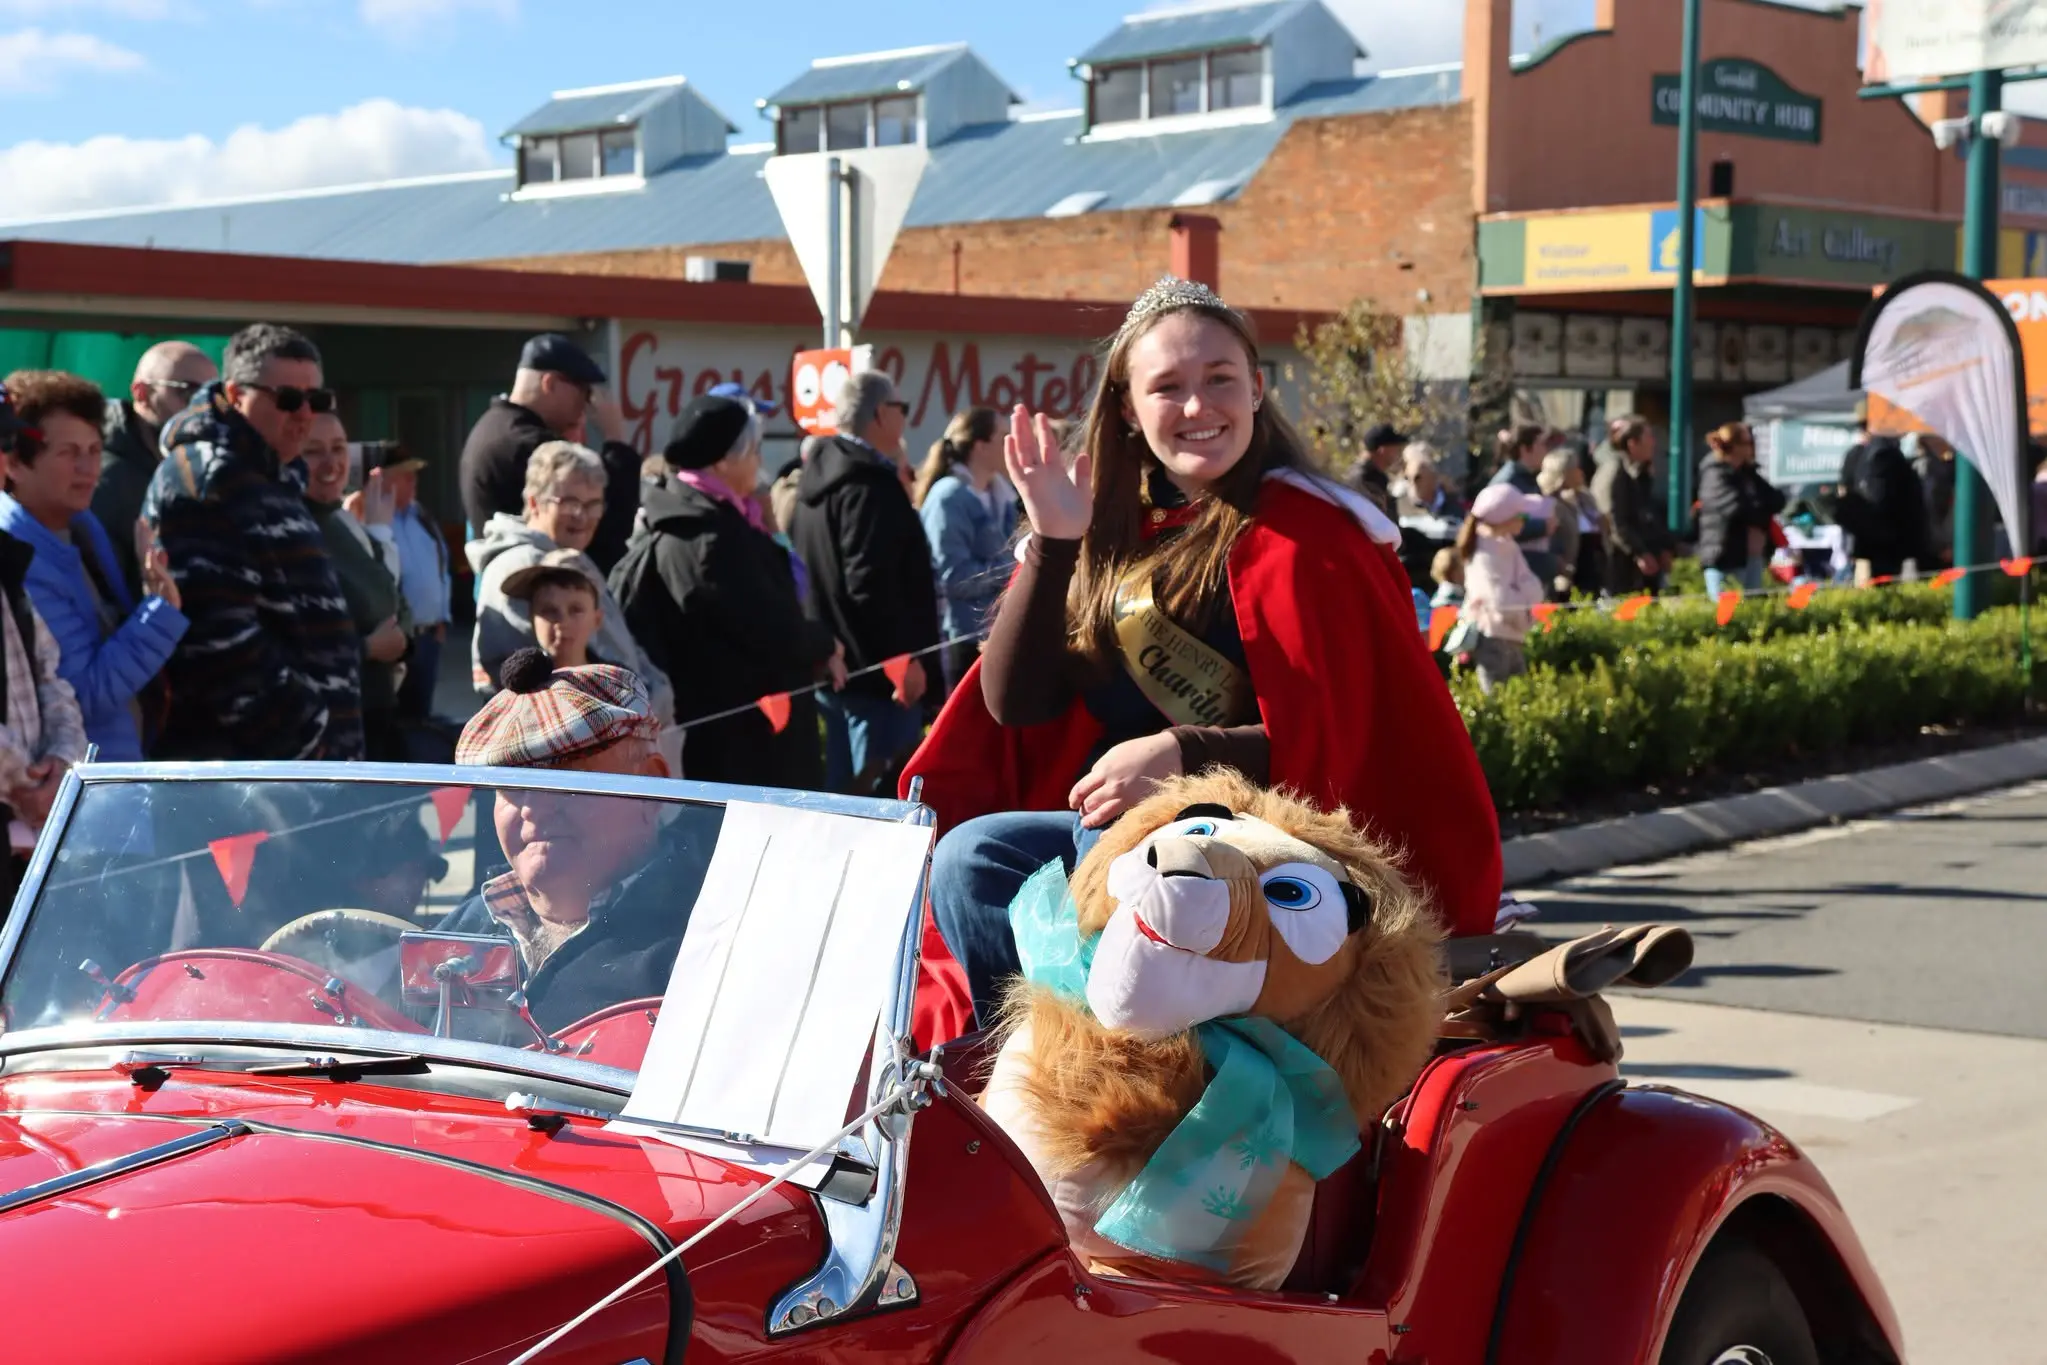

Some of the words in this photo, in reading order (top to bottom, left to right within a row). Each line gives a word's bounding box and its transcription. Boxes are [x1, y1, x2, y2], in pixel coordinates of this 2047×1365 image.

[1656, 87, 1769, 124] COMUNITY
[1774, 103, 1814, 132] HUB
[1769, 218, 1811, 256] Art
[1822, 226, 1898, 273] Gallery
[910, 341, 1097, 428] Motel
[1140, 609, 1168, 641] THE
[1164, 634, 1223, 678] HENRY
